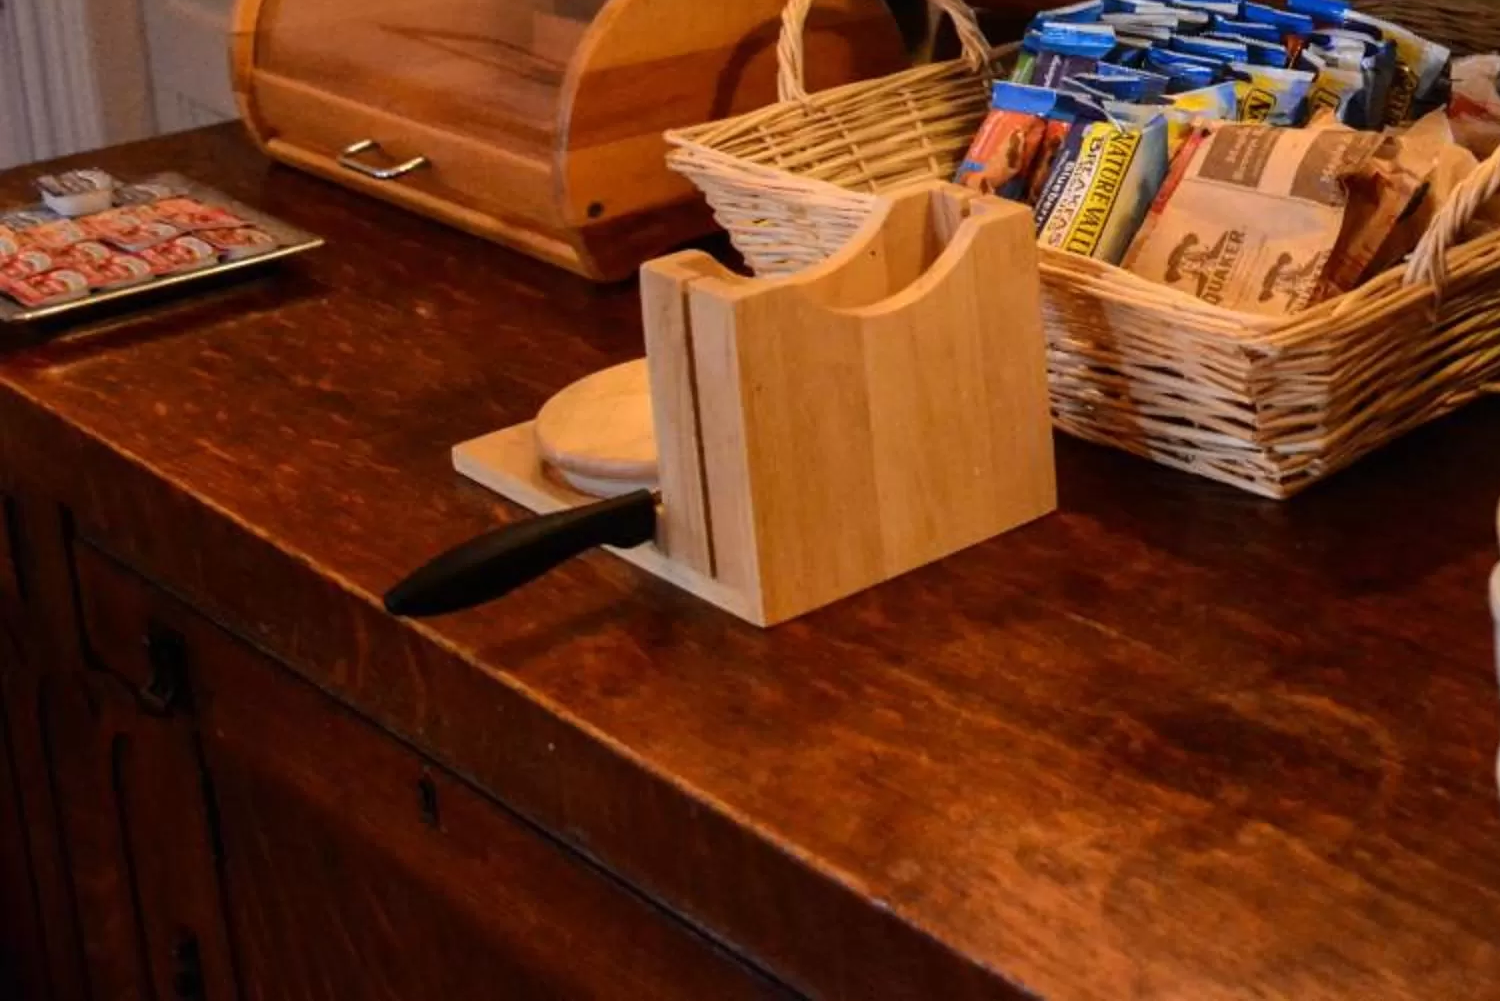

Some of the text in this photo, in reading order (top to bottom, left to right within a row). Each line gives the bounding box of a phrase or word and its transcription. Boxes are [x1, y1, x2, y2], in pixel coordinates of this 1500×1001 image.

[1048, 137, 1103, 248] BREAKFAS
[1066, 130, 1136, 255] NATURE VALL
[1202, 229, 1245, 305] QUAKER
